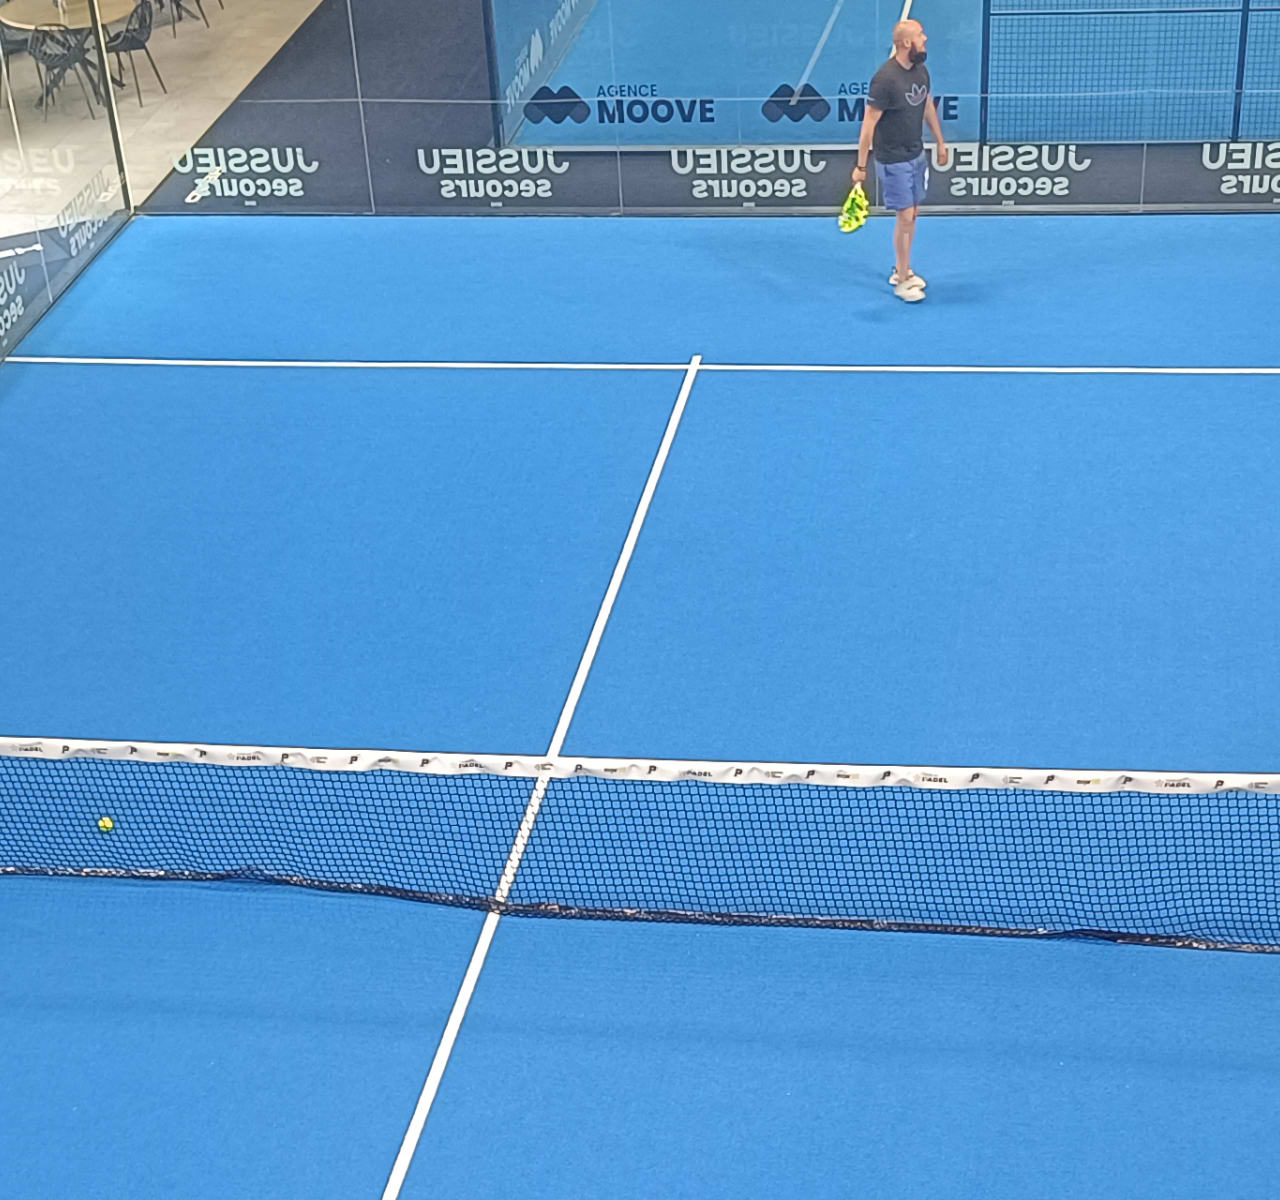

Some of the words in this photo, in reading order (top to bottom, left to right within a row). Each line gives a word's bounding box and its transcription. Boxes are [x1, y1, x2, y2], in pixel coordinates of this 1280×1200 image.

[596, 84, 659, 98] AGENCE
[838, 82, 870, 95] AGE
[597, 99, 716, 124] MOOVE
